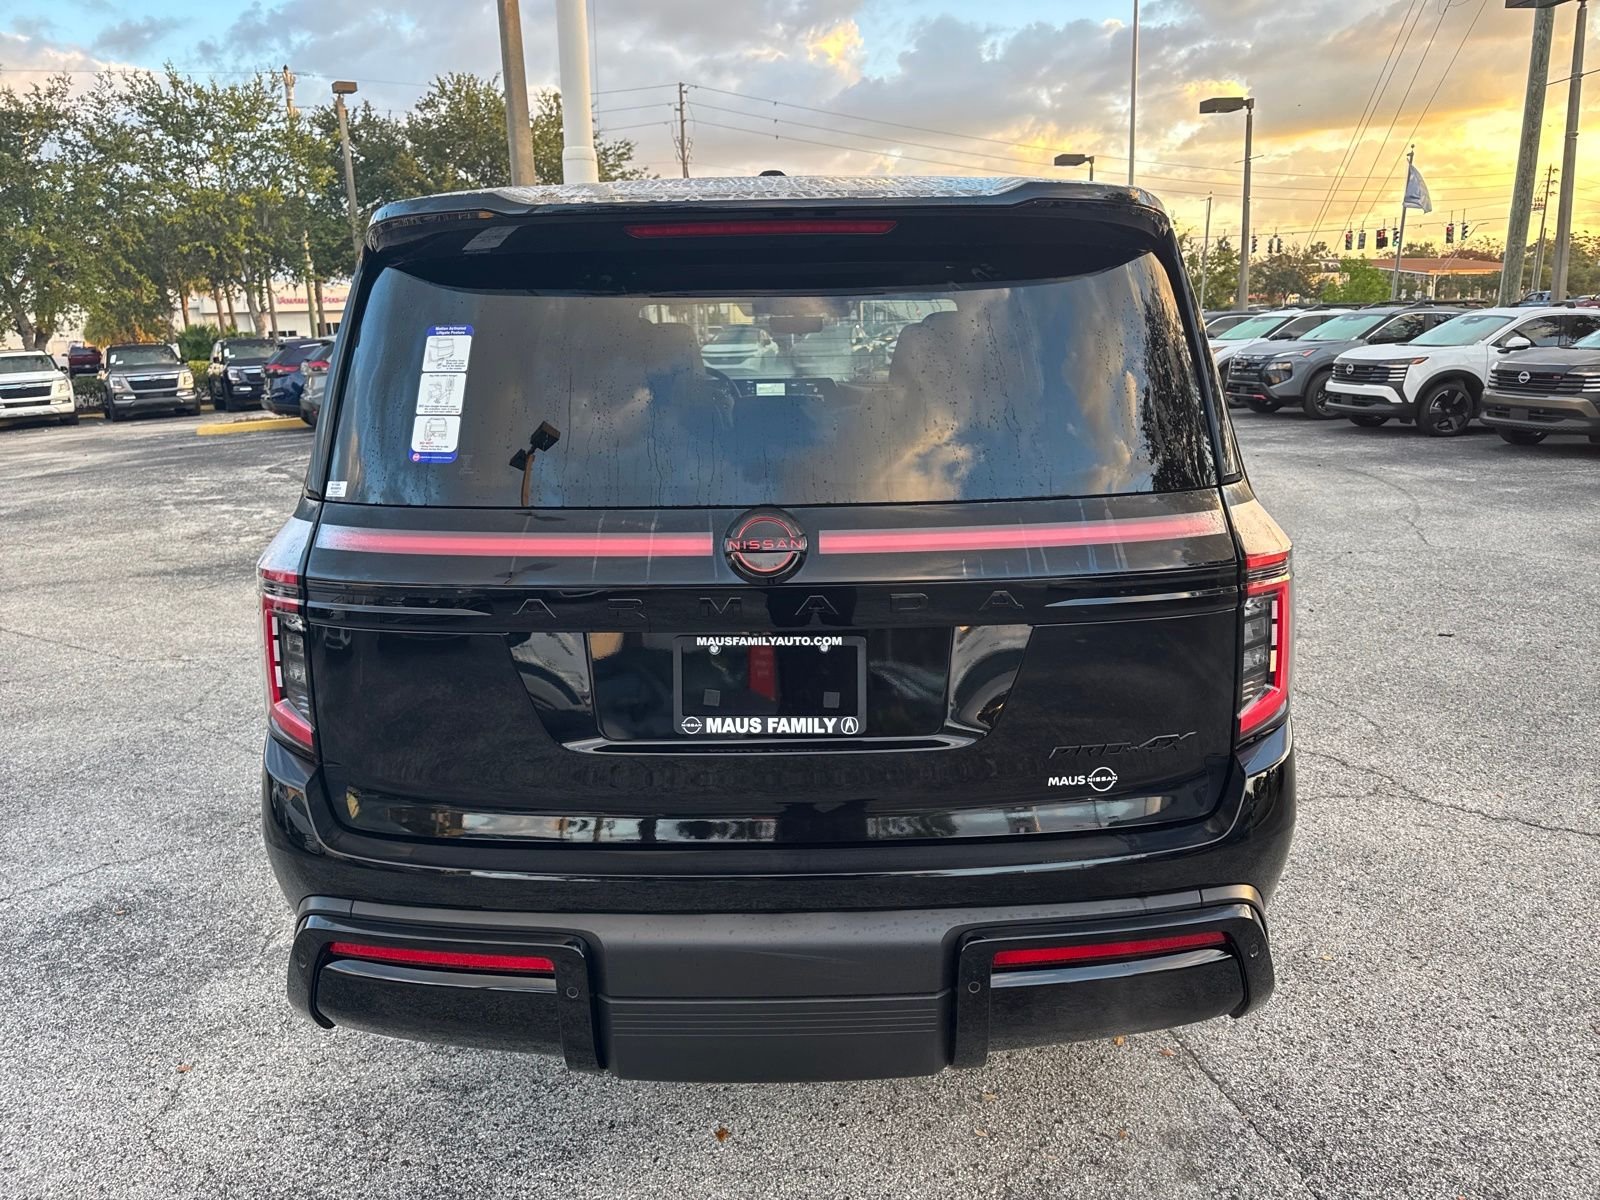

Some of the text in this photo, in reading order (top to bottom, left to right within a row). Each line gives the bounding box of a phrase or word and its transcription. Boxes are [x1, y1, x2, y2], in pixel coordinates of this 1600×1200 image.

[726, 537, 804, 551] NISSAN
[512, 590, 1025, 619] ARMADA
[696, 636, 843, 646] MAUSFAMILYAUTO.COM
[705, 717, 762, 734] MAUS
[767, 717, 838, 734] FAMILY
[1047, 775, 1086, 787] MAUS
